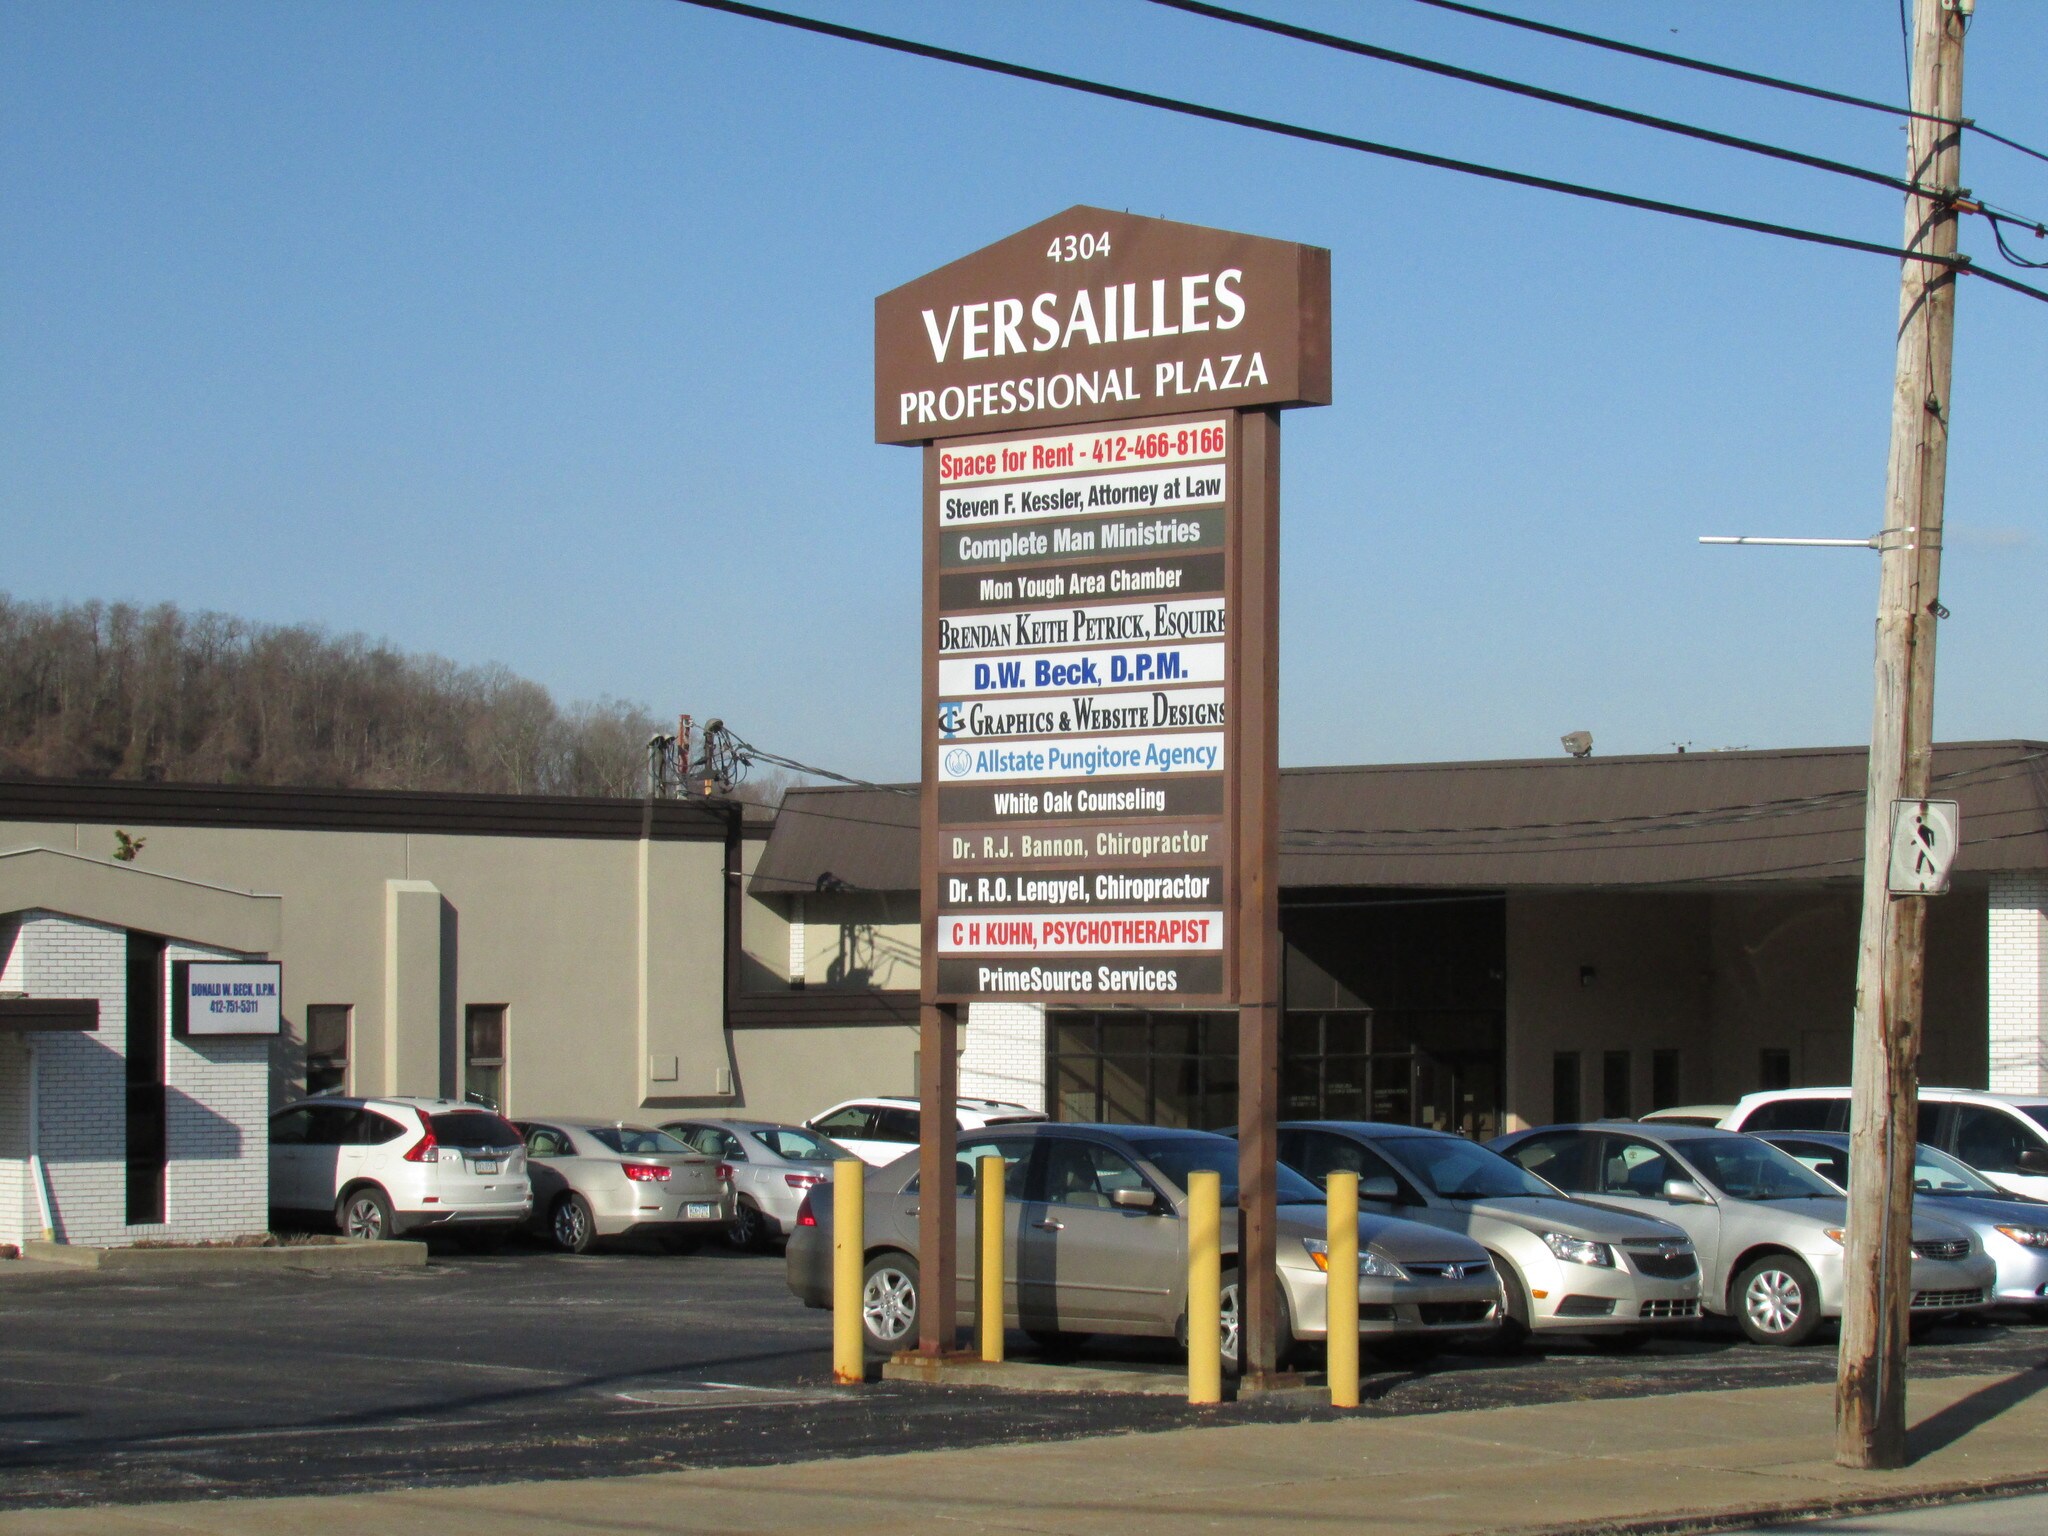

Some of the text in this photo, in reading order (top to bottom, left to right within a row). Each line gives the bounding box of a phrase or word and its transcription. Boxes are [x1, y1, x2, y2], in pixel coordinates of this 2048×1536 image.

[1047, 231, 1111, 263] 4304
[921, 268, 1246, 364] VERSAILLES
[900, 352, 1269, 426] PROFESSIONAL PLAZA
[941, 453, 996, 480] Space
[1002, 448, 1027, 473] for
[1032, 442, 1073, 470] Rent
[1092, 426, 1224, 464] 412-466-8166
[946, 476, 1221, 520] Steven F. Kessler, Attorney at Law
[959, 519, 1200, 562] Complete Man Ministries
[980, 567, 1182, 601] Mon Yough Area Chamber
[939, 619, 1011, 650] BRENDAN
[1015, 613, 1068, 646] KEITH
[1072, 609, 1150, 642] PETRICK,
[974, 651, 1188, 690] D.W. Beck, D.P.M.
[970, 703, 1054, 735] GRAPHICS
[1059, 711, 1072, 731] &
[1072, 697, 1149, 731] WEBSITE
[975, 743, 1217, 775] Allstate Pungitore Agency
[994, 788, 1166, 815] White Oak Counseling
[953, 830, 1209, 859] Dr. R.J. Bannon, Chiropractor
[949, 874, 1210, 904] Dr. R.O. Lengyel, Chiropractor
[952, 919, 1210, 949] C H KUHN, PSYCHOTHERAPIST
[191, 983, 221, 996] DONALD
[256, 983, 276, 996] D.P.M.
[978, 966, 1178, 992] PrimeSource Services
[210, 1000, 258, 1013] 412-751-5311
